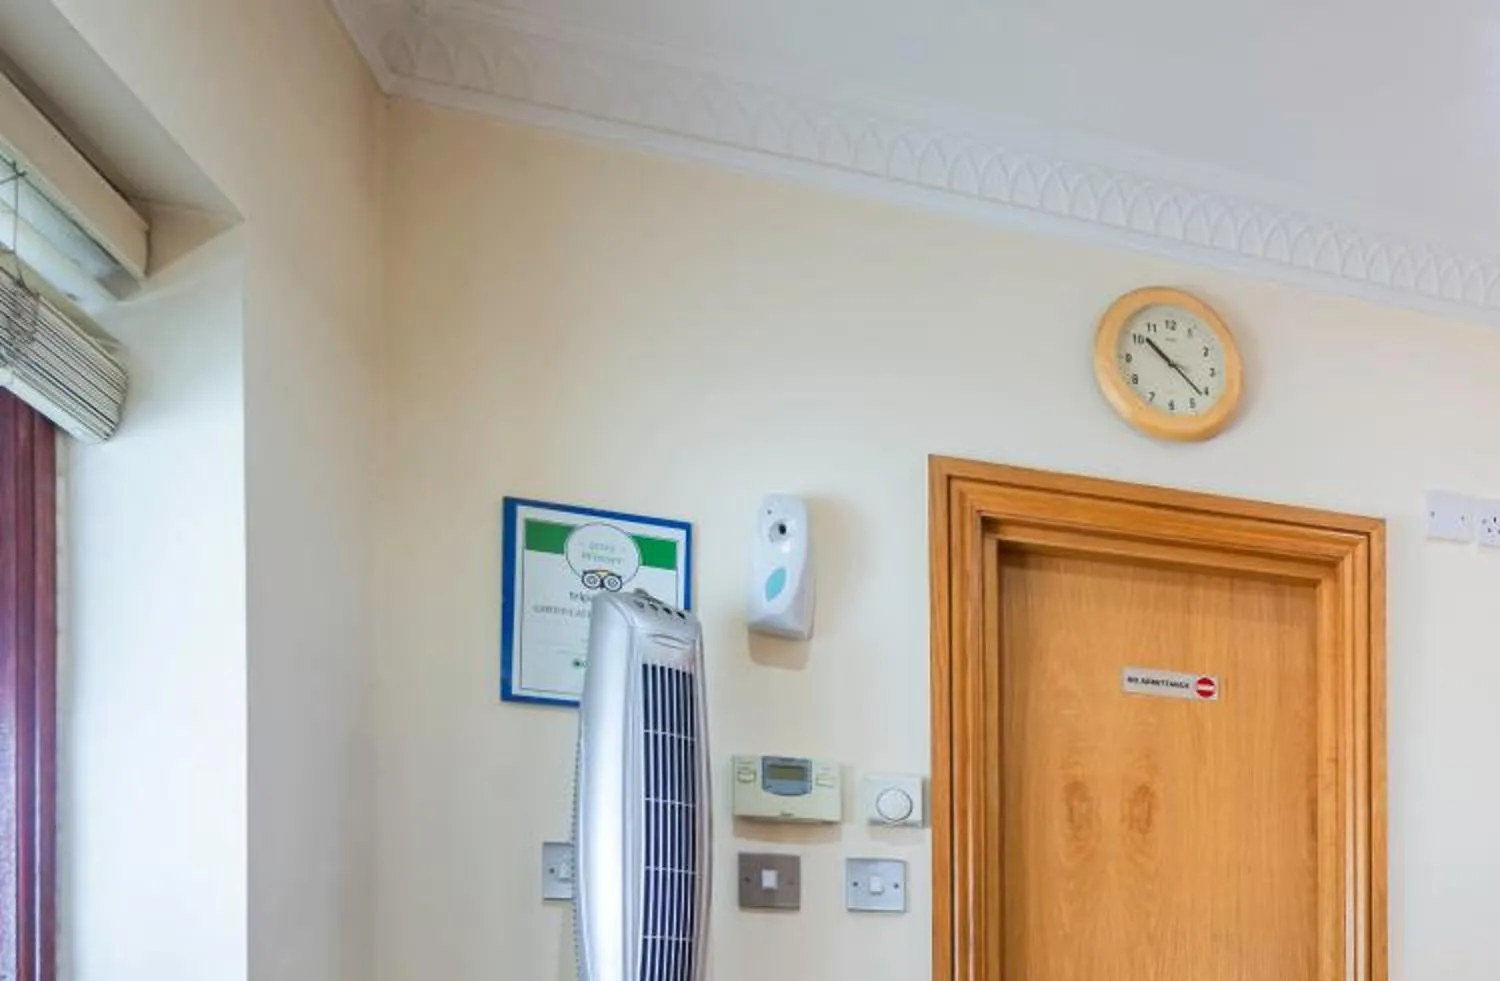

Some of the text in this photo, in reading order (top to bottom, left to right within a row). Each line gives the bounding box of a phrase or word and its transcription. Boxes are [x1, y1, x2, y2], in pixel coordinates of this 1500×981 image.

[1147, 322, 1157, 333] 11
[1165, 319, 1177, 331] 12
[1132, 333, 1145, 345] 10
